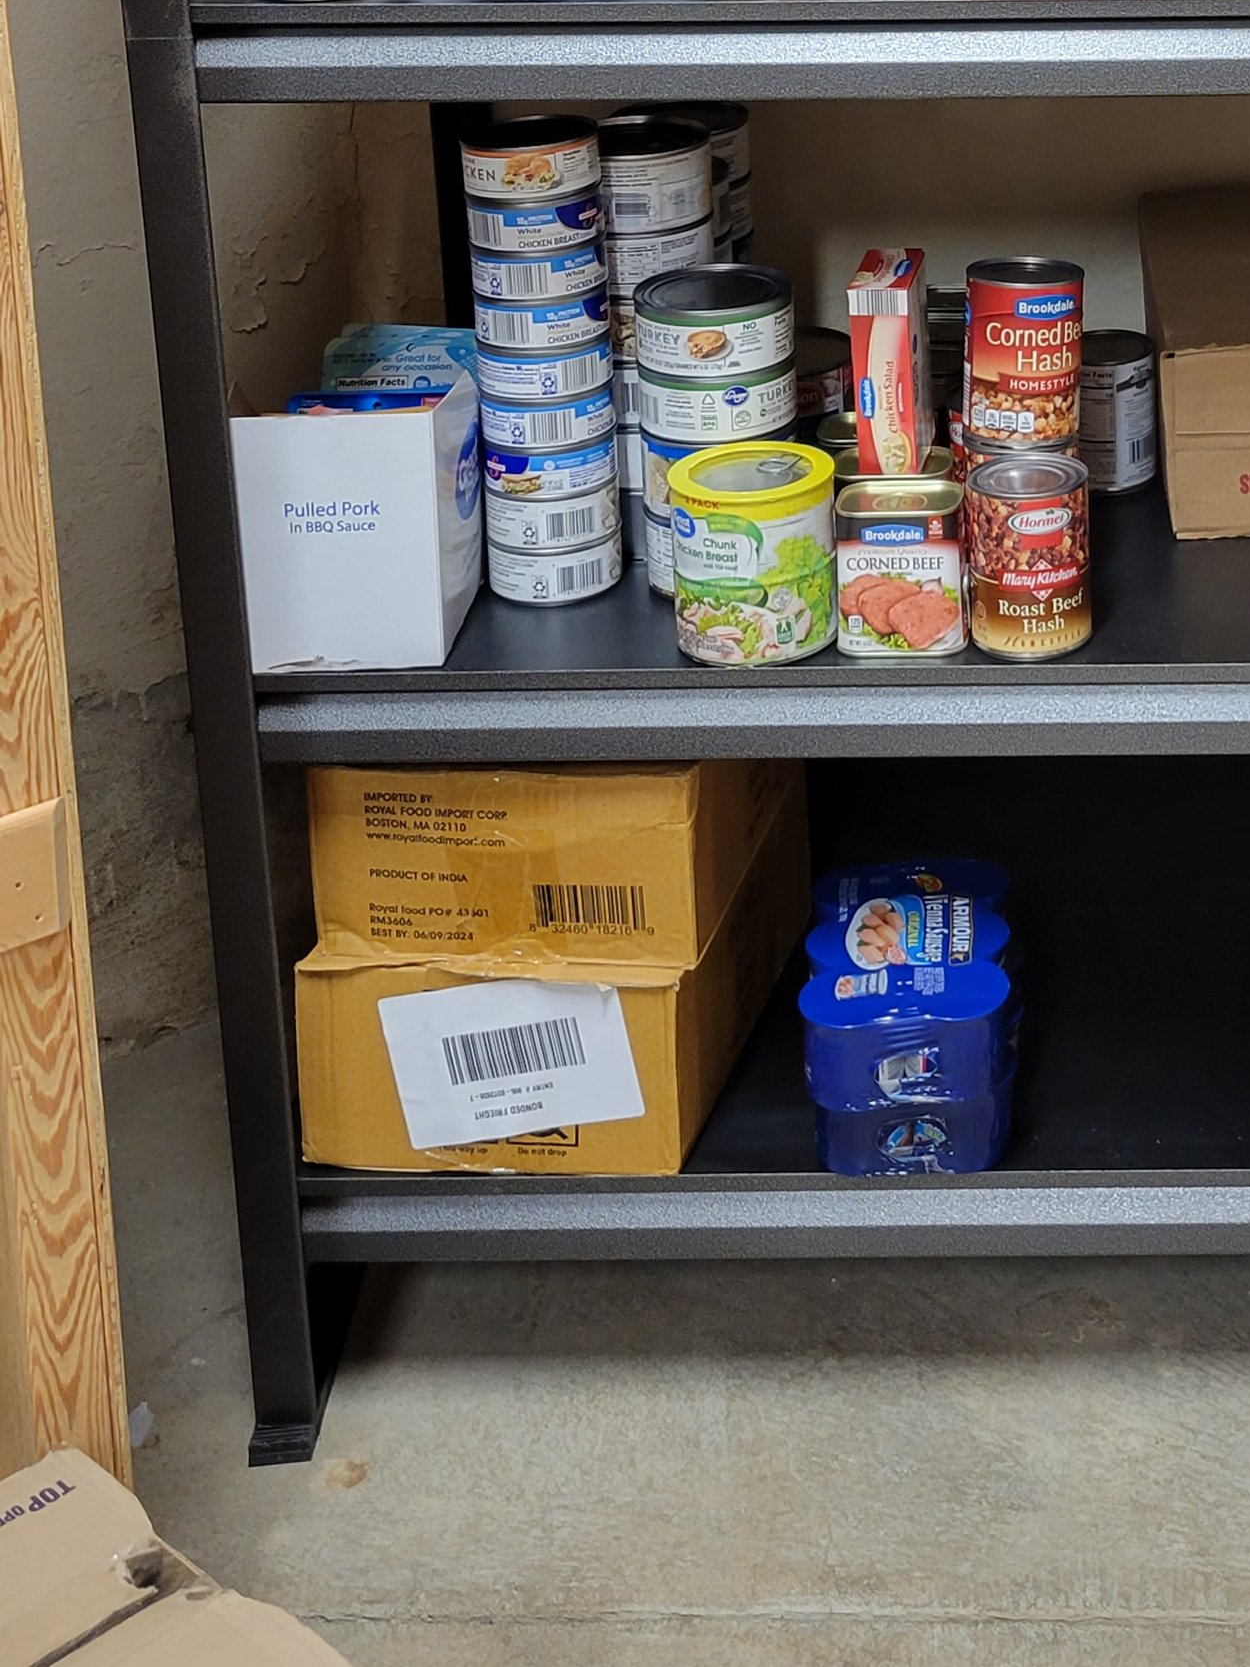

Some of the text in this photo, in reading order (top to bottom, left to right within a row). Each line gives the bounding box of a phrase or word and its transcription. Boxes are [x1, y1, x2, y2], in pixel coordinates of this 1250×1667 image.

[517, 227, 542, 235] White
[1018, 298, 1073, 316] Brookdale
[395, 354, 441, 362] Great for
[1016, 347, 1072, 373] Hash
[381, 378, 406, 386] Facts
[1008, 374, 1075, 391] HOMESTYLE
[283, 500, 381, 518] Pulled Pork
[289, 519, 376, 534] In BBQ Sauce
[1016, 511, 1065, 530] Hormel
[865, 528, 922, 542] Brookdale
[702, 537, 738, 552] Chunk
[846, 556, 944, 571] CORNED BEEF
[998, 591, 1084, 618] Roast Beef
[1022, 615, 1065, 633] Hash
[369, 868, 468, 883] PRODUCT OF INDIA
[952, 896, 970, 953] ARMOUR
